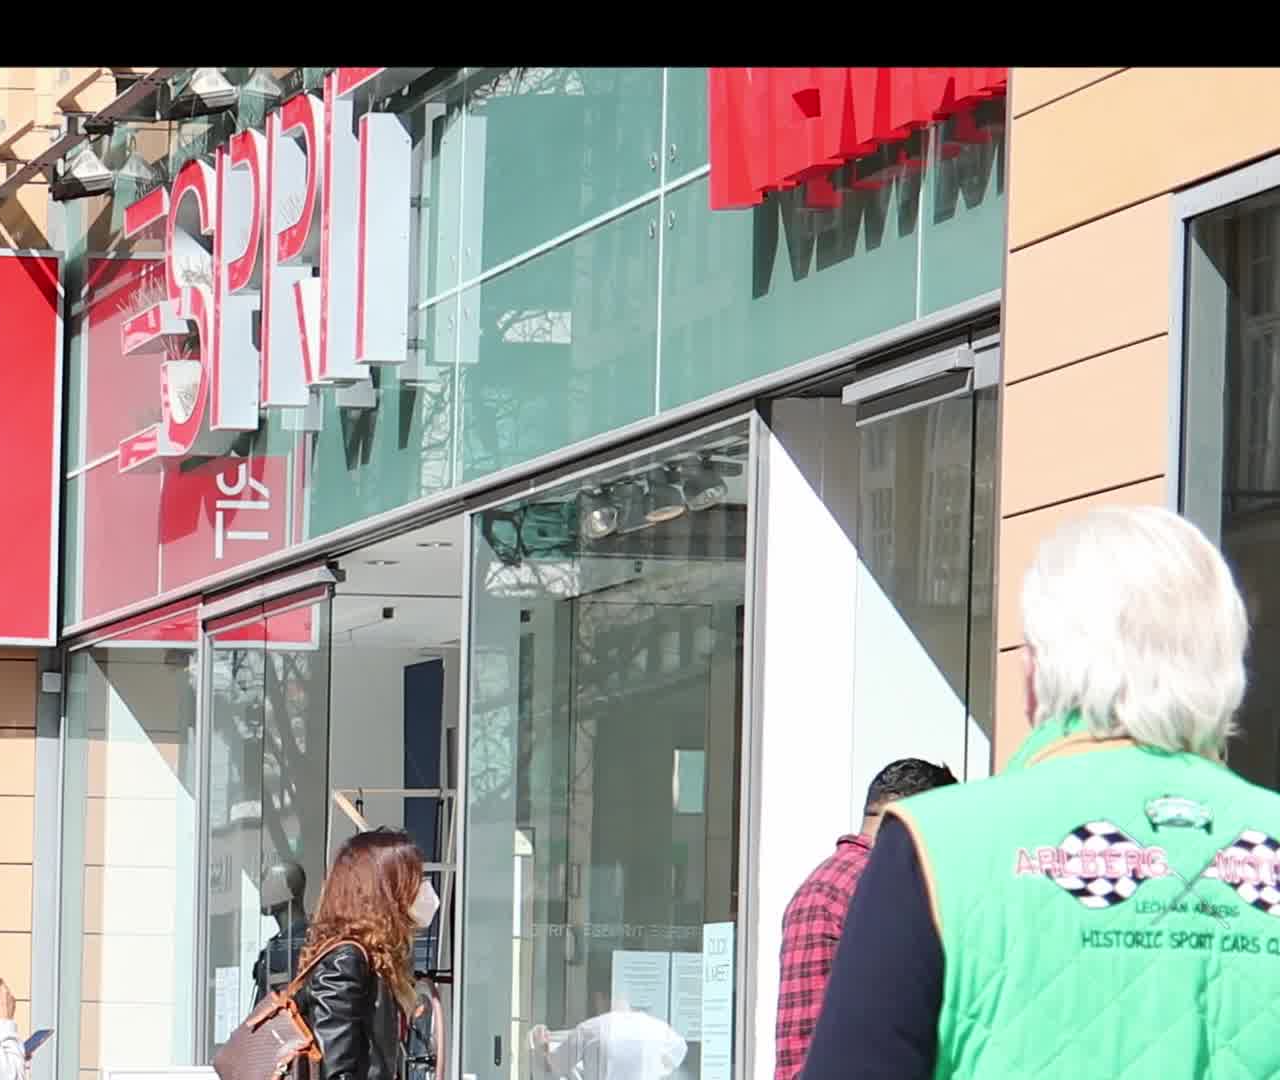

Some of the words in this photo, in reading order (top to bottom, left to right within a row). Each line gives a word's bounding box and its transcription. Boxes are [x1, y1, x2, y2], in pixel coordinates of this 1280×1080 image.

[1081, 931, 1163, 950] HISTORIC
[1170, 931, 1214, 949] SPORT
[1220, 934, 1261, 953] CARS
